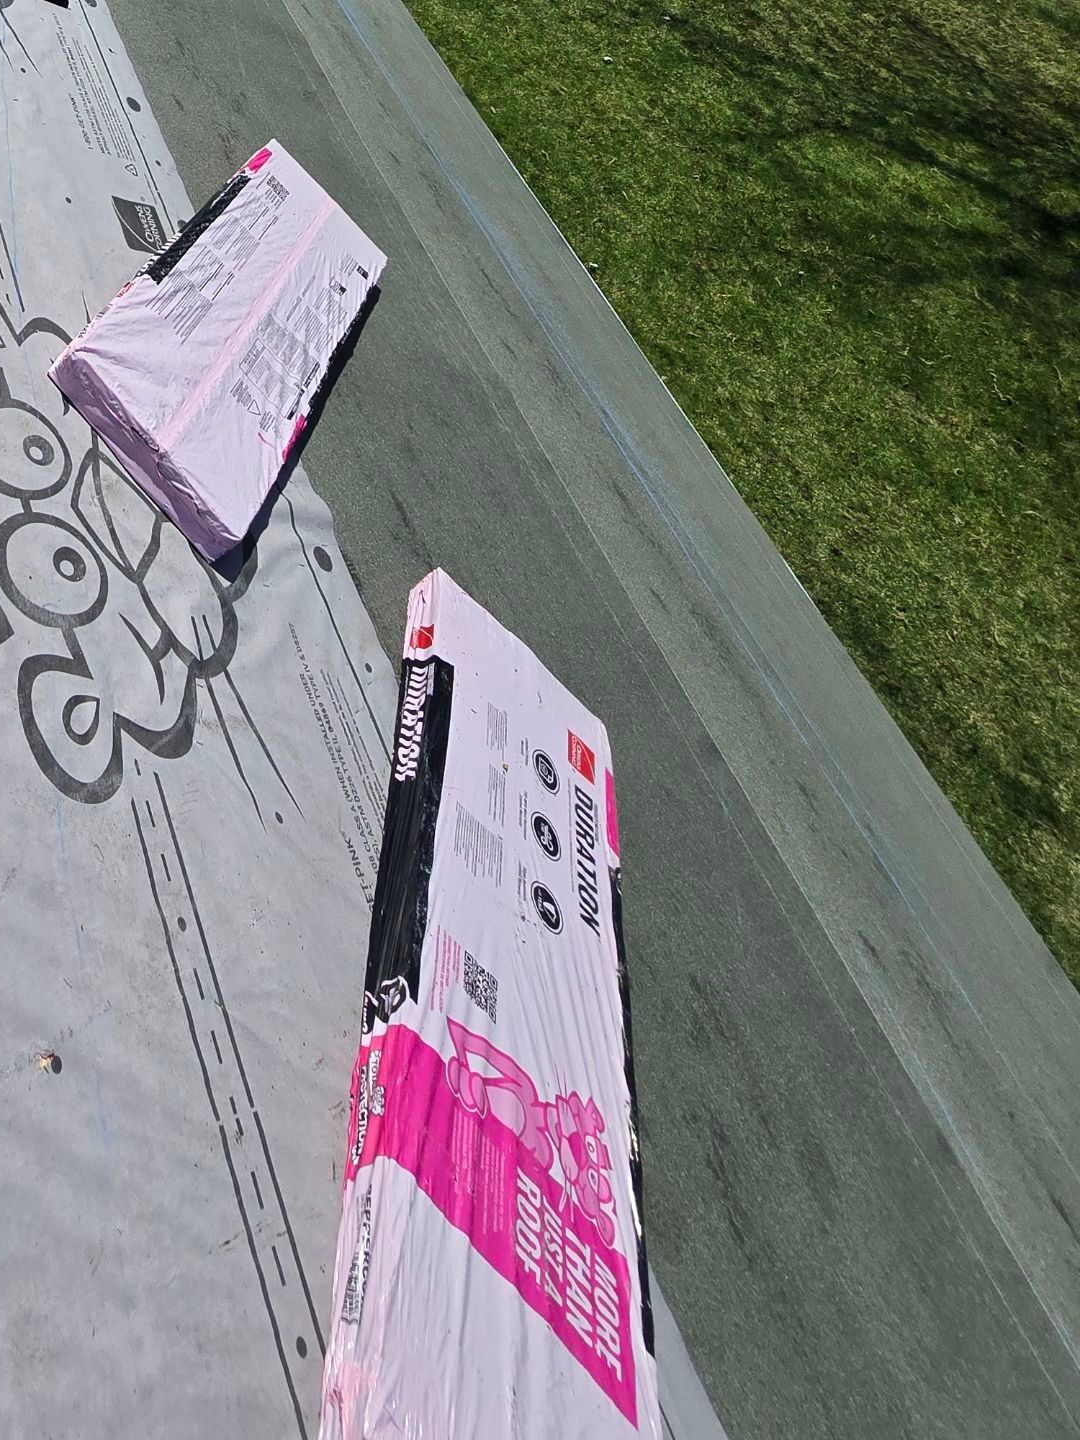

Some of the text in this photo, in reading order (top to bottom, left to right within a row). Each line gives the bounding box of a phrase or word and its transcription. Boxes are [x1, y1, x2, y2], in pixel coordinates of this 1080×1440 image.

[136, 203, 155, 243] OWENS
[298, 670, 317, 707] UNDER
[307, 673, 322, 699] TYPE
[312, 706, 338, 764] INSTALLED
[334, 744, 349, 773] TYPE
[333, 764, 354, 804] (WHEN
[352, 813, 372, 853] CLASS
[356, 803, 373, 836] ASTM
[575, 784, 601, 939] DURATION
[516, 1166, 540, 1284] ROOF
[542, 1194, 563, 1306] JUST A
[564, 1227, 591, 1347] THAN
[594, 1252, 623, 1378] MORE
